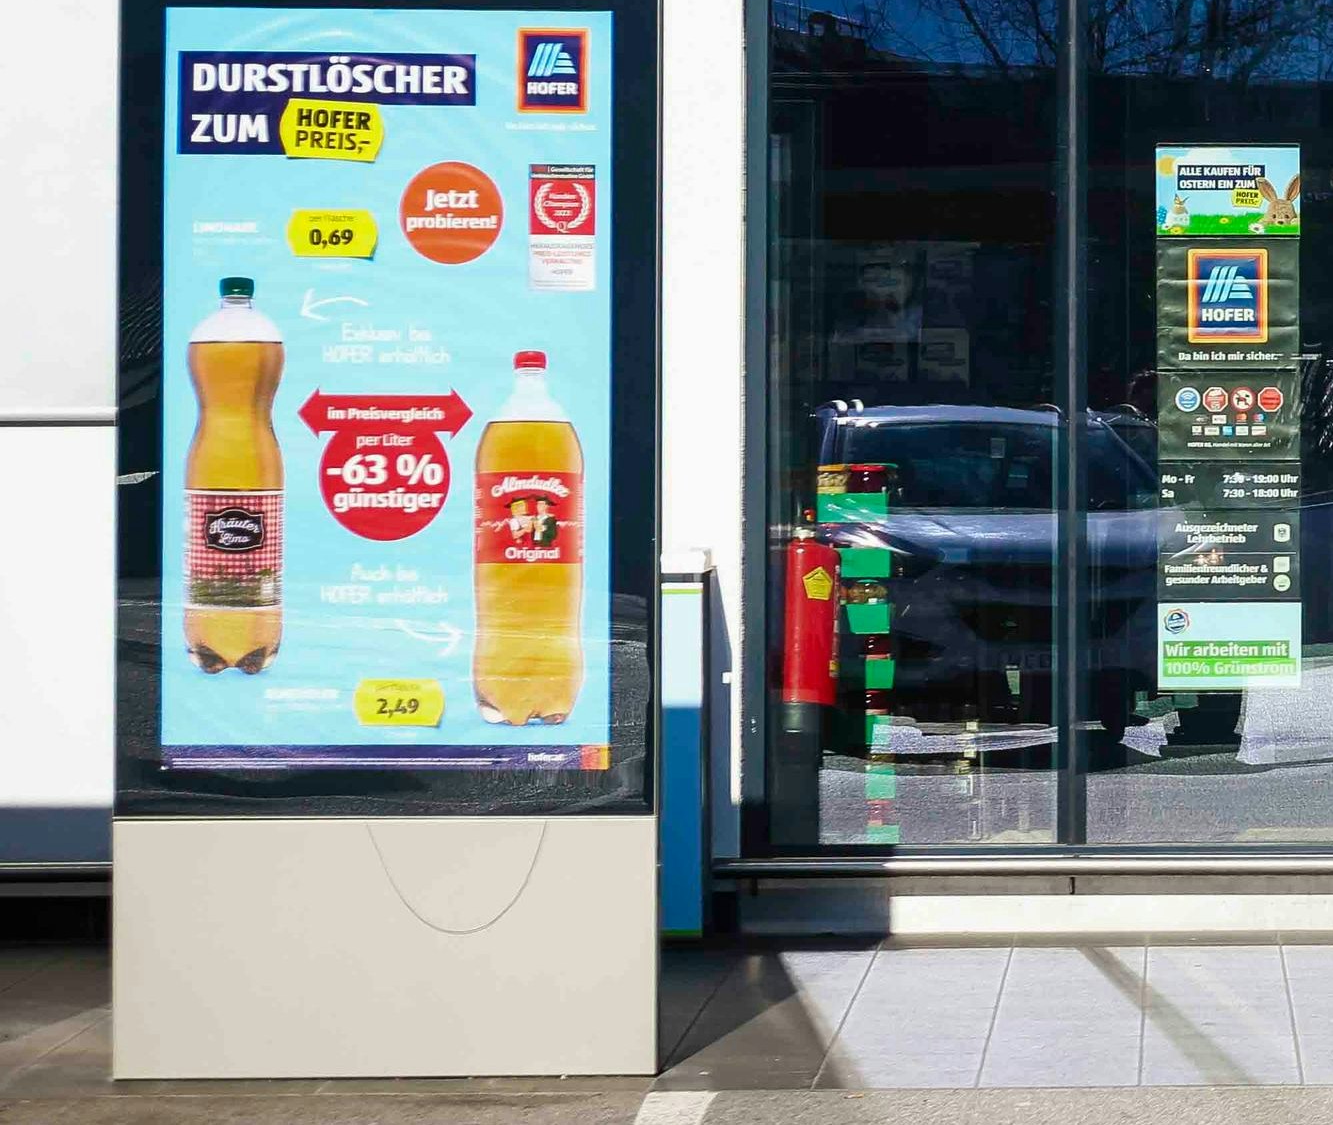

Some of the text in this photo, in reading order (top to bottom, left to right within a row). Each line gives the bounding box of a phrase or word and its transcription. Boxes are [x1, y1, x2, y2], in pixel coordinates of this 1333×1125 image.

[191, 55, 469, 96] DURSTLÖSCHER
[526, 81, 579, 96] HOFER
[296, 107, 372, 132] HOFER
[190, 112, 270, 144] ZUM
[294, 130, 371, 155] PREIS,-
[1179, 164, 1262, 176] ALLE KAUFEN FÜR
[1179, 179, 1256, 189] OSTERN EIN ZUM
[424, 188, 479, 212] Jetzt
[1236, 190, 1259, 199] HOFER
[405, 210, 498, 233] probieren!
[308, 228, 354, 249] 0,69
[1201, 308, 1255, 322] HOFER
[1178, 351, 1279, 361] Da bin ich mir sicher.
[327, 406, 446, 425] im Preisvergleich
[356, 433, 414, 450] per Liter
[326, 455, 443, 486] -63 %
[1161, 474, 1177, 484] Mo
[1184, 474, 1196, 484] Fr
[1280, 474, 1299, 484] Uhr
[333, 487, 443, 514] günstiger
[1161, 488, 1175, 499] Sa
[1223, 488, 1244, 498] 7:30
[1252, 488, 1279, 498] 18:00
[1280, 488, 1299, 498] Uhr
[1174, 522, 1259, 535] Ausgezeichneter
[1187, 533, 1247, 544] Lehrbetrieb
[504, 546, 561, 562] Original
[1164, 564, 1268, 574] Familienfreundlicher &
[1165, 575, 1267, 586] gesunder Arbeitgeber
[1165, 642, 1289, 657] Wir arbeiten mit
[1166, 660, 1295, 675] 100% Grünstrom
[375, 697, 420, 719] 2,49
